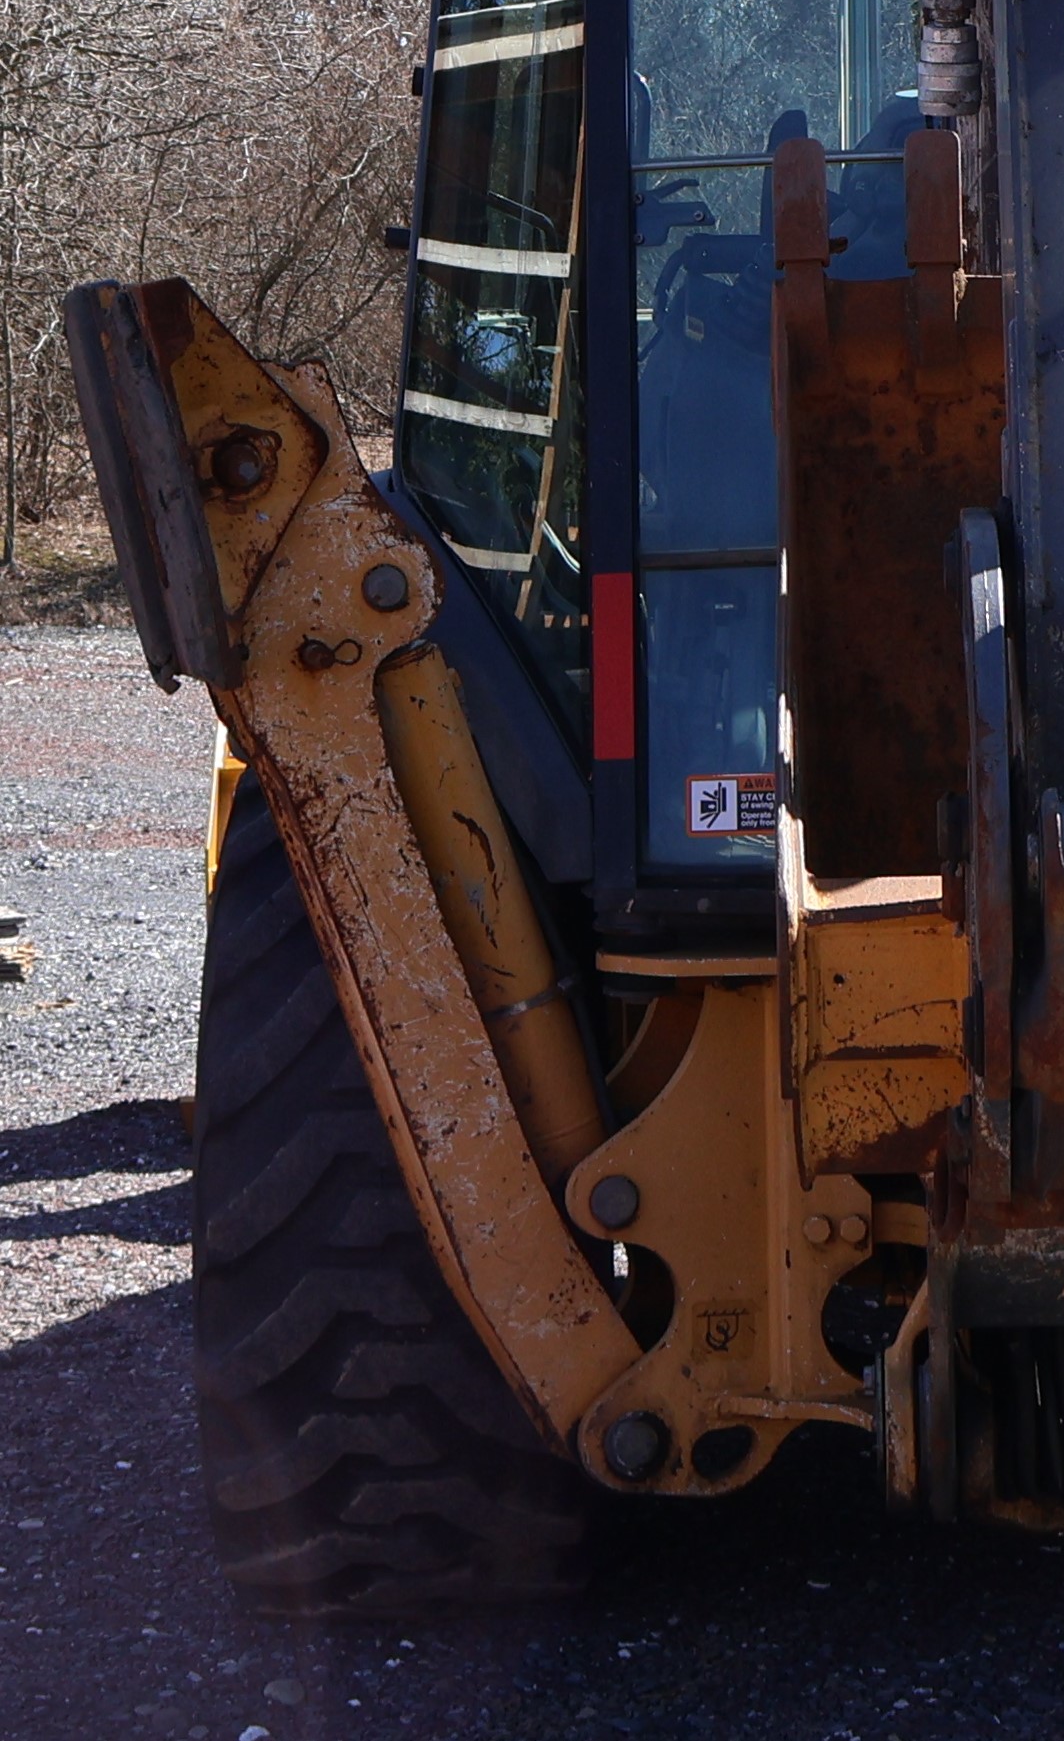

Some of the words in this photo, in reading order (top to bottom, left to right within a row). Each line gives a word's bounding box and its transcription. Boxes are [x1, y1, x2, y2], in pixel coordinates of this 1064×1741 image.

[741, 793, 764, 801] STAY
[751, 802, 774, 810] swing
[741, 812, 772, 821] Operate
[741, 820, 758, 828] only
